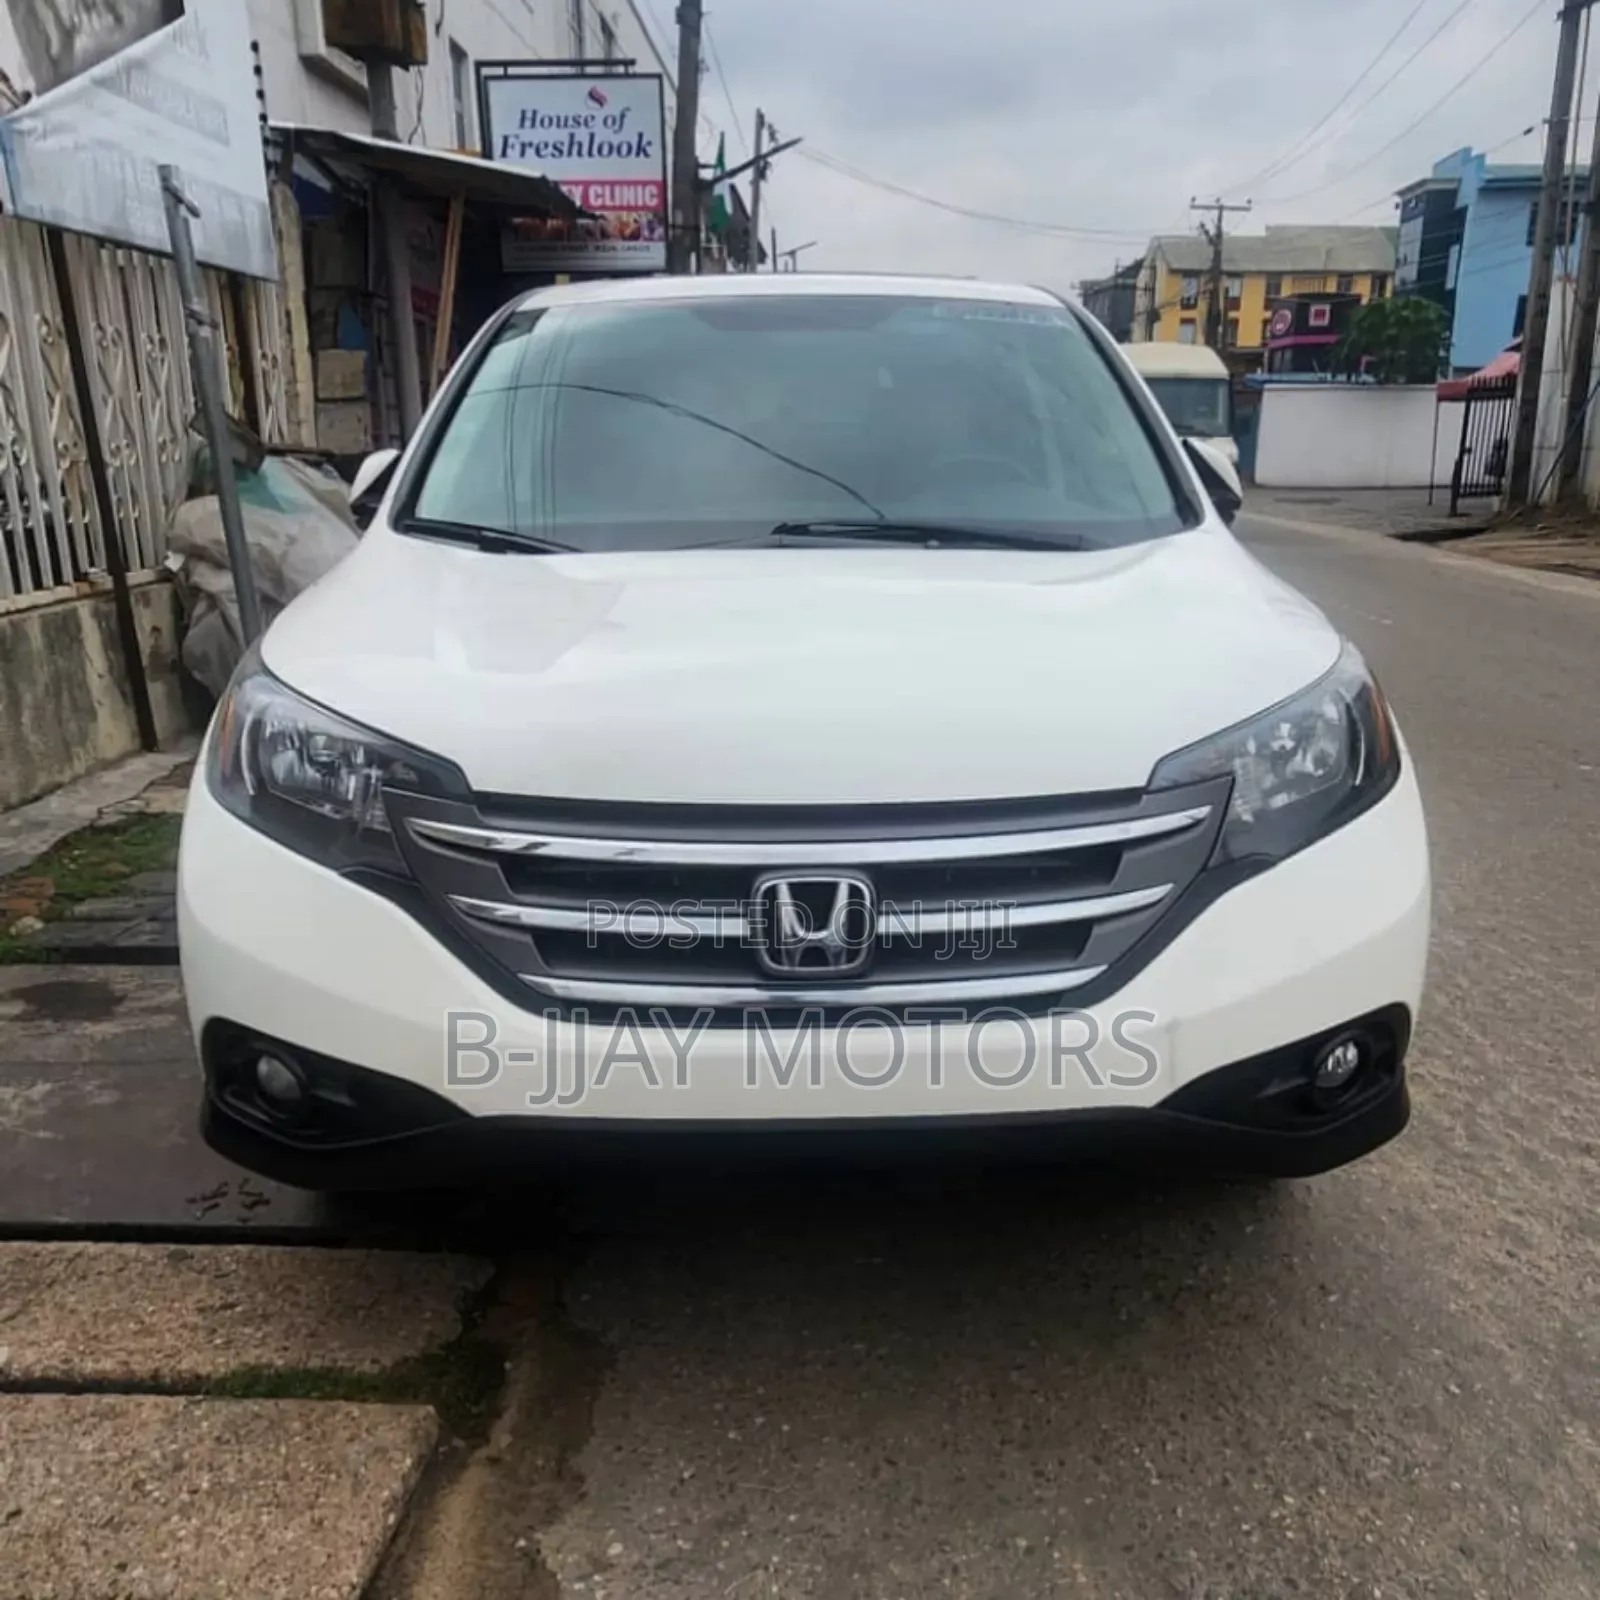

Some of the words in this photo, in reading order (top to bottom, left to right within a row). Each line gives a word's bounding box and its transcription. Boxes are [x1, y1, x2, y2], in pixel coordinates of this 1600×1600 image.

[518, 109, 596, 130] House
[602, 107, 631, 134] of
[499, 132, 653, 159] Freshlook
[588, 184, 658, 207] CLINIC
